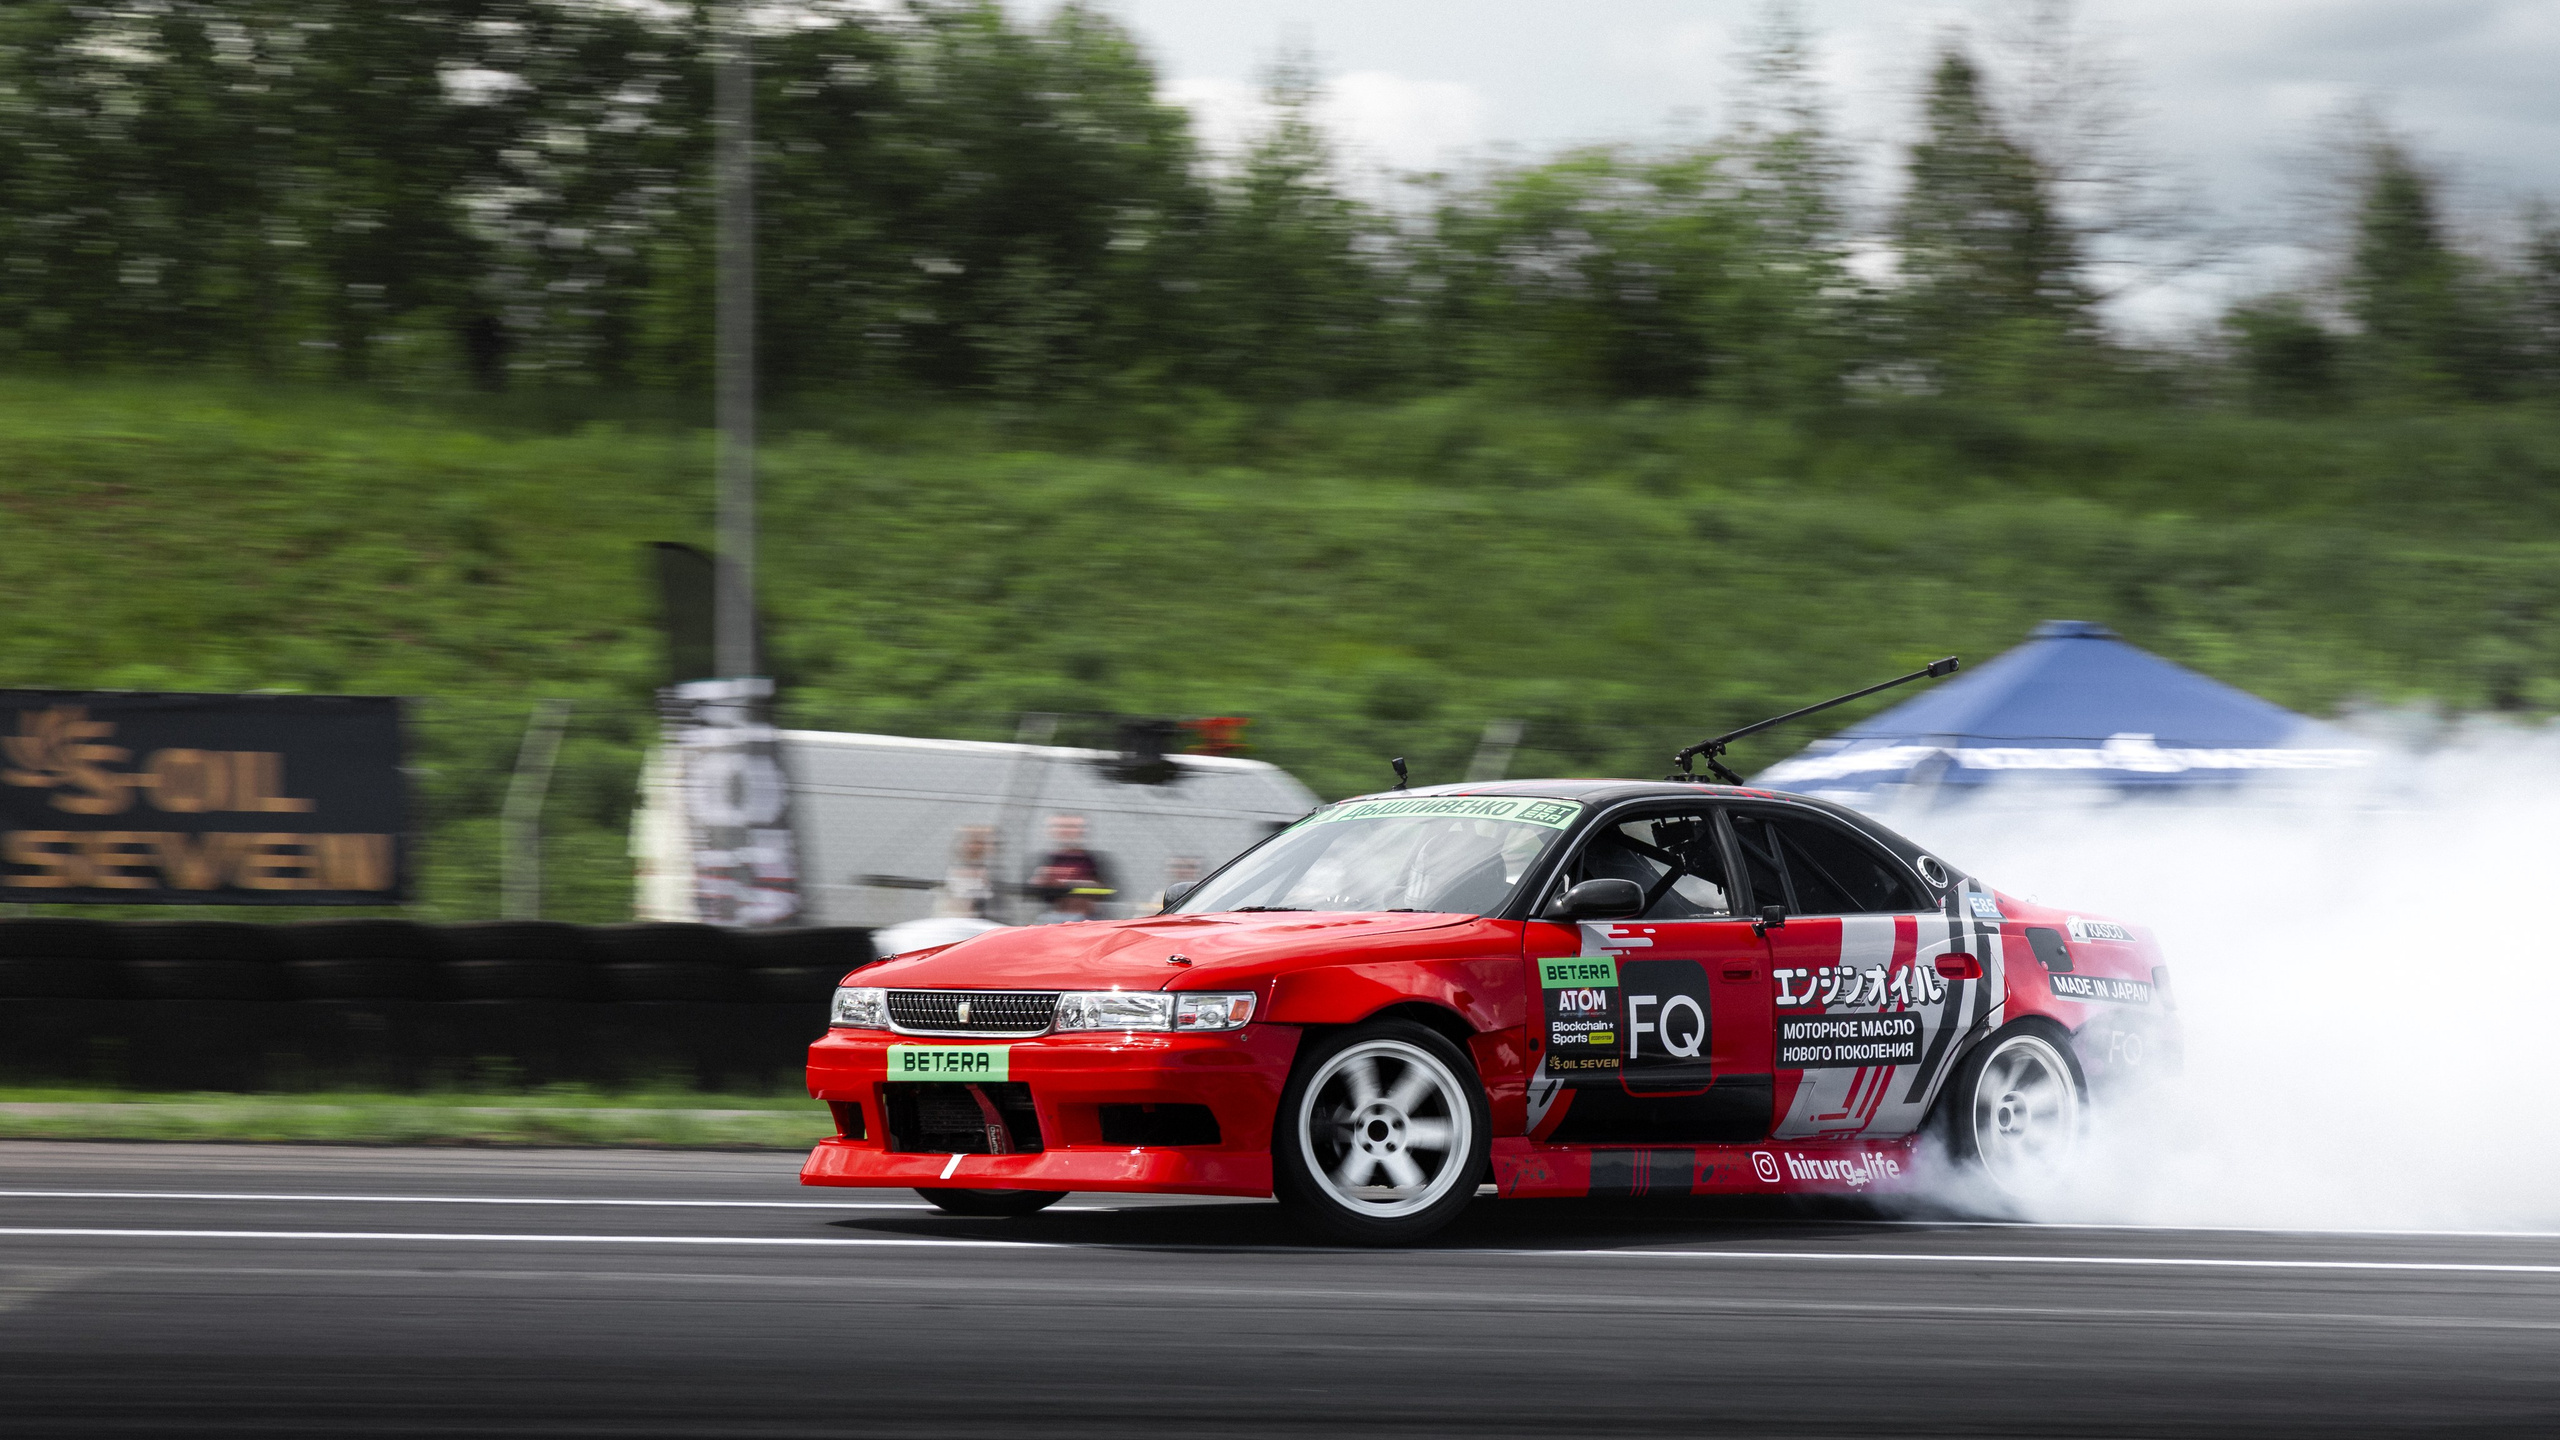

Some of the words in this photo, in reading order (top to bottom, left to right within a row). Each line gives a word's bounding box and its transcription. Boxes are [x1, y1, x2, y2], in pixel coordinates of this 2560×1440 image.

[1969, 897, 1997, 913] E85
[2086, 923, 2124, 939] KASCO
[1773, 964, 1943, 1006] エンジンオイル
[2053, 976, 2092, 996] MADE
[2094, 981, 2109, 997] IN
[2111, 981, 2149, 1002] JAPAN
[1559, 989, 1607, 1011] ATOM
[1552, 1020, 1608, 1032] Blockchain
[1628, 994, 1705, 1060] FQ
[1783, 1021, 1858, 1040] МОТОРНОЕ
[1861, 1018, 1915, 1037] МАСЛО
[1552, 1033, 1588, 1046] Sports
[2108, 1030, 2144, 1066] FQ
[1783, 1046, 1832, 1062] НОВОГО
[1835, 1042, 1914, 1060] ПОКОЛЕНИЯ
[1580, 1058, 1620, 1068] SEVEN
